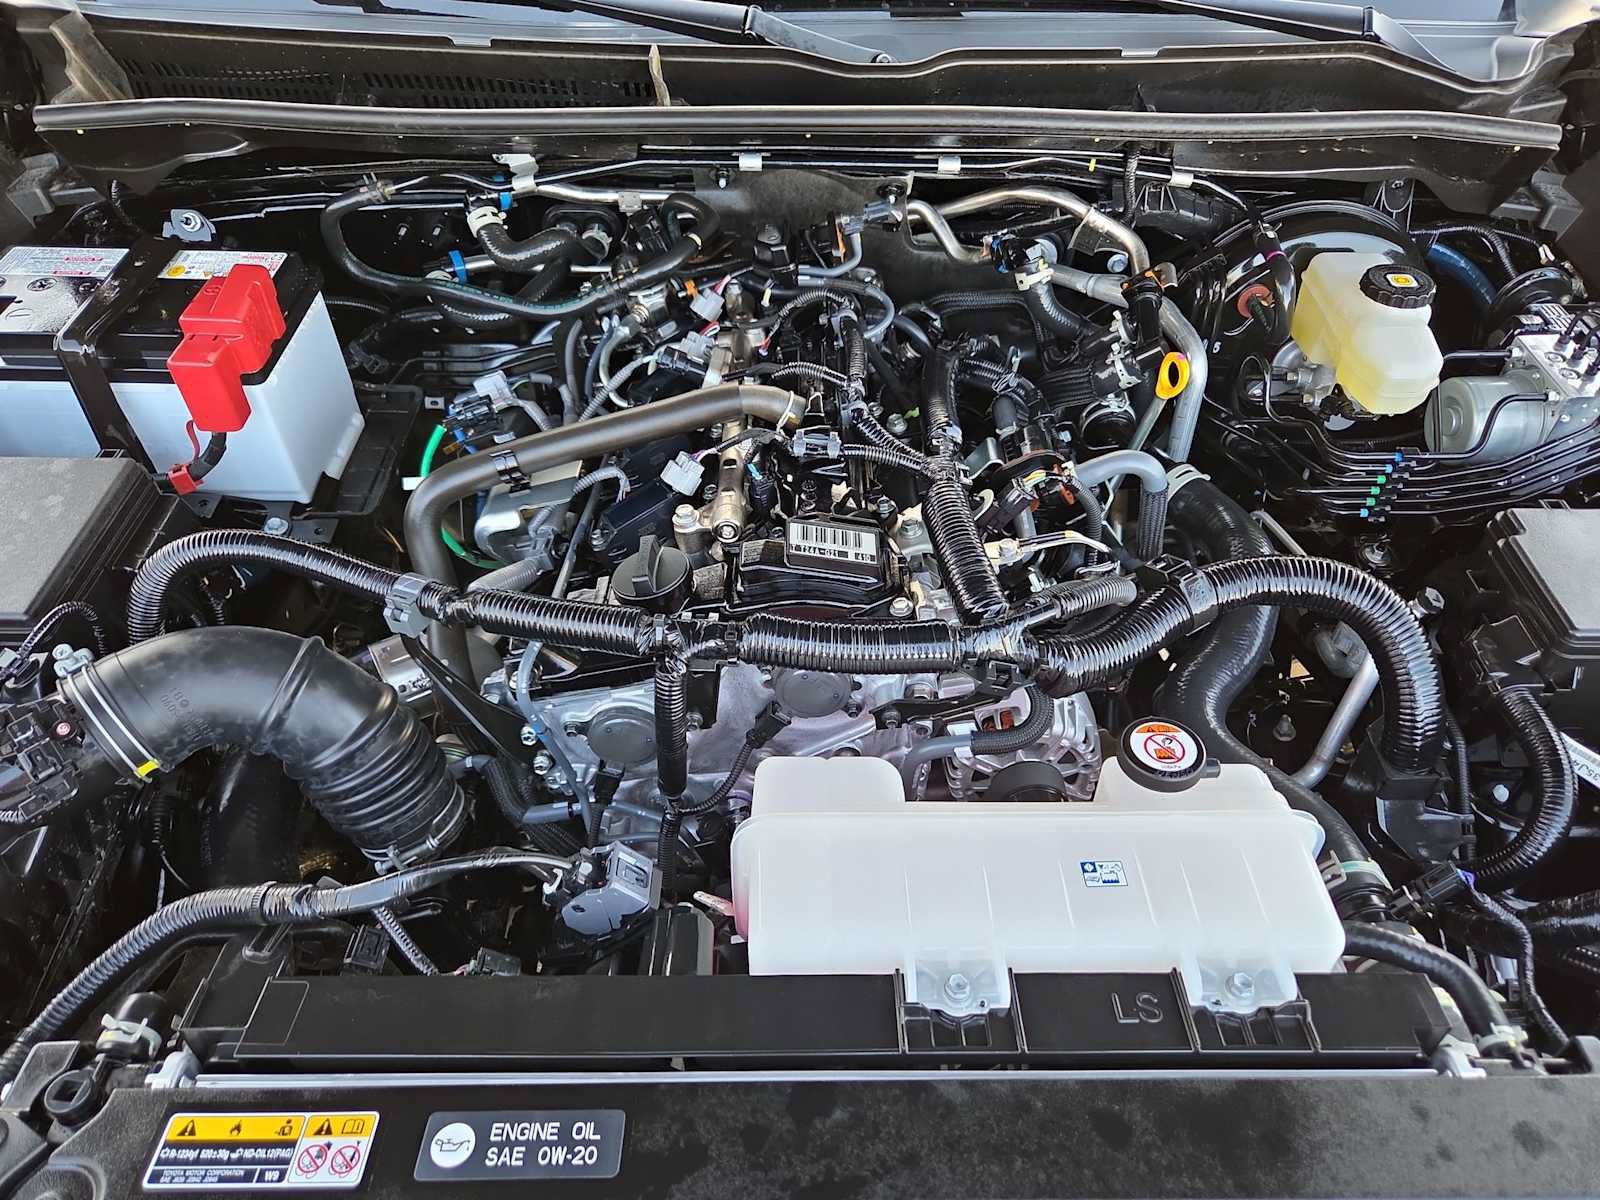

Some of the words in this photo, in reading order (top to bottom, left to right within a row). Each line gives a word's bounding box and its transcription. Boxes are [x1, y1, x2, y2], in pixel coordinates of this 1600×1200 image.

[1111, 992, 1164, 1024] LS
[489, 1121, 561, 1142] ENGINE
[571, 1121, 601, 1141] OIL
[485, 1146, 526, 1167] SAE
[537, 1145, 598, 1166] 0W-20
[162, 1169, 185, 1177] TOYOTA
[206, 1168, 245, 1176] CORPORATION
